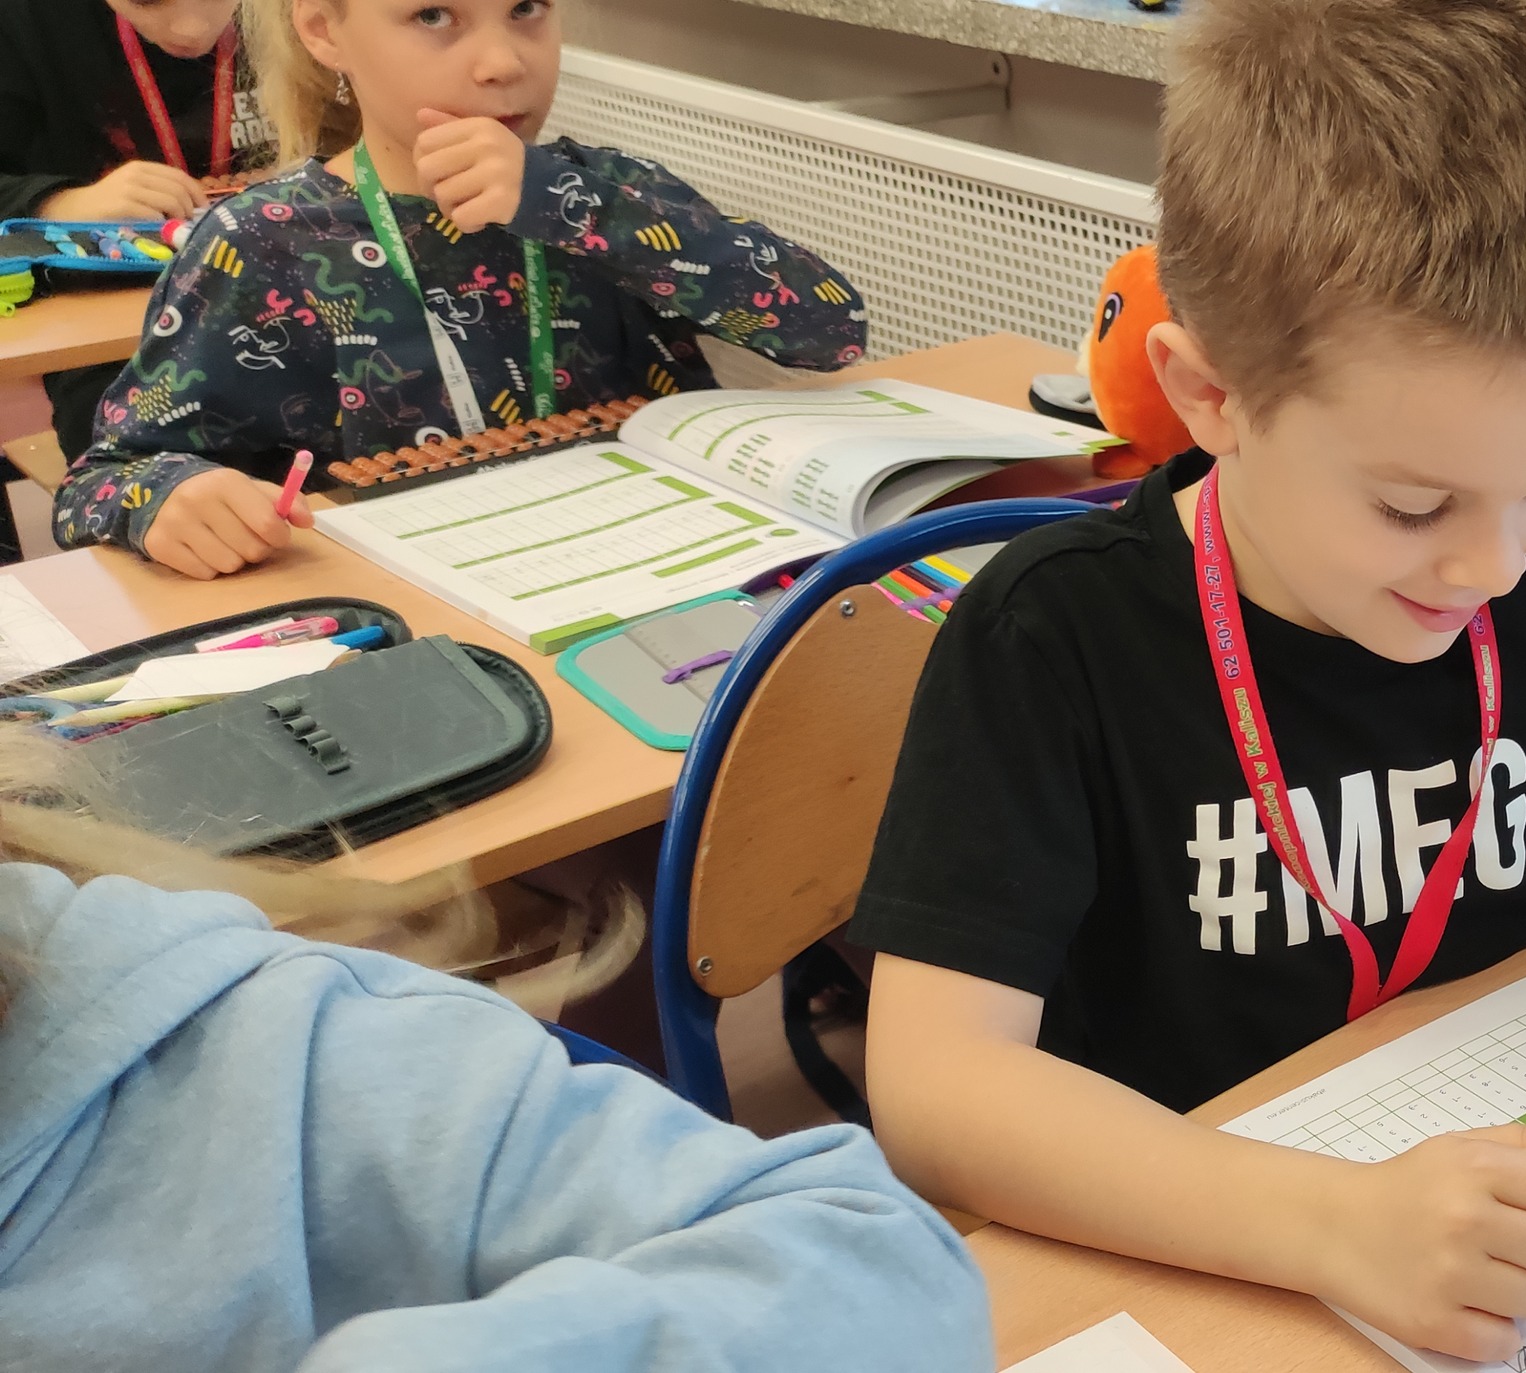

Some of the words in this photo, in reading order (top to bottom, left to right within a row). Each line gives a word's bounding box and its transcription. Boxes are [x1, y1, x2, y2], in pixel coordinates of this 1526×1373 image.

[1222, 654, 1242, 680] 62
[1480, 644, 1496, 712] Kaliszu
[1233, 687, 1264, 758] Kaliszu
[1253, 761, 1270, 780] w
[1257, 781, 1316, 895] onopnickiej
